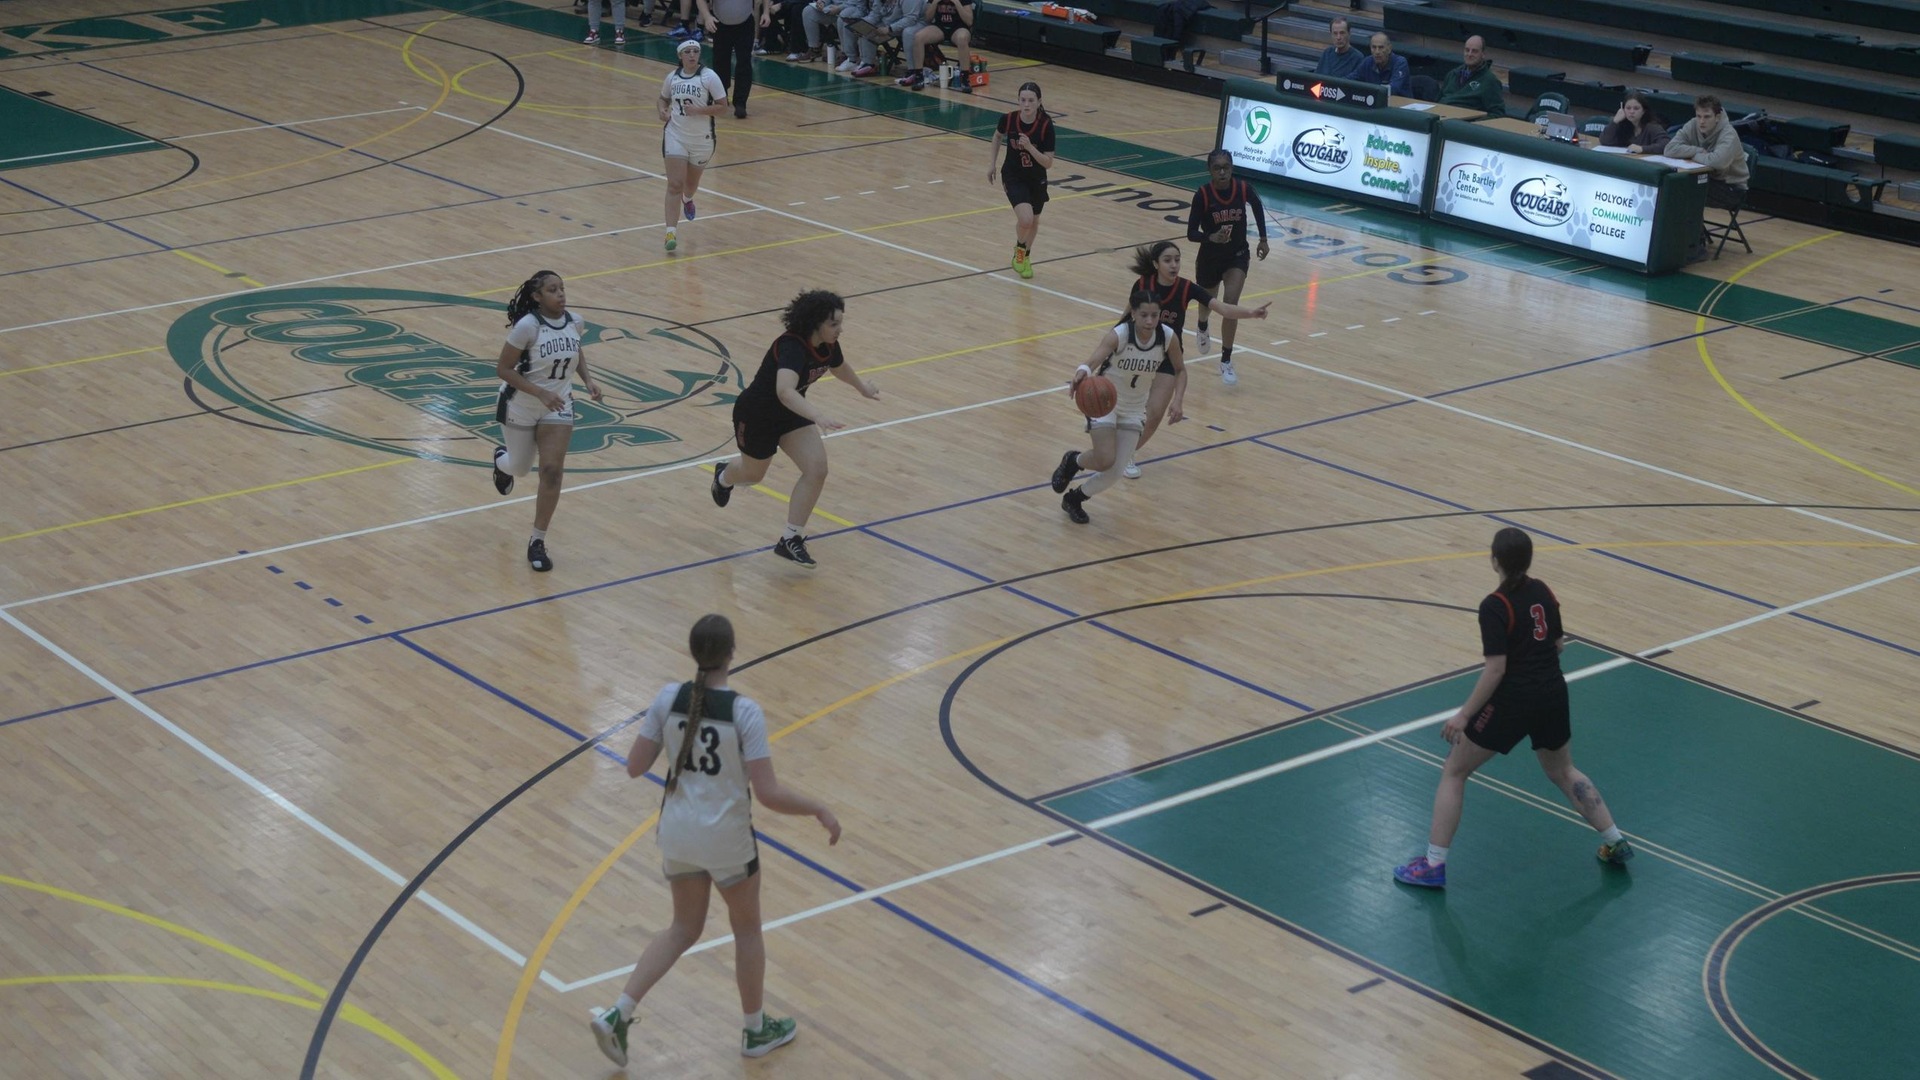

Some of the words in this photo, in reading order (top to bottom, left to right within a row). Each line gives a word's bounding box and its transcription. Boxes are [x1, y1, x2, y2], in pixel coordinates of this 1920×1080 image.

[976, 75, 983, 84] G
[1320, 86, 1337, 99] POSS
[1351, 94, 1366, 103] BONUS
[1243, 146, 1263, 155] Holyoke
[1295, 142, 1348, 164] COUGARS
[1366, 134, 1414, 157] Educate.
[1020, 151, 1033, 168] 2
[1233, 150, 1255, 162] Birthplace
[1262, 156, 1285, 168] Volleyball
[1364, 154, 1402, 174] Inspire.
[1361, 171, 1410, 195] Connect.
[1456, 180, 1479, 194] Center
[1458, 169, 1470, 181] The
[1472, 172, 1497, 190] Bartley
[1513, 191, 1570, 217] COUGARS
[1595, 191, 1634, 208] HOLYOKE
[1592, 207, 1644, 227] COMMUNITY
[1589, 222, 1626, 239] COLLEGE
[547, 357, 572, 380] 11
[1130, 374, 1140, 389] 1
[1530, 603, 1548, 641] 3
